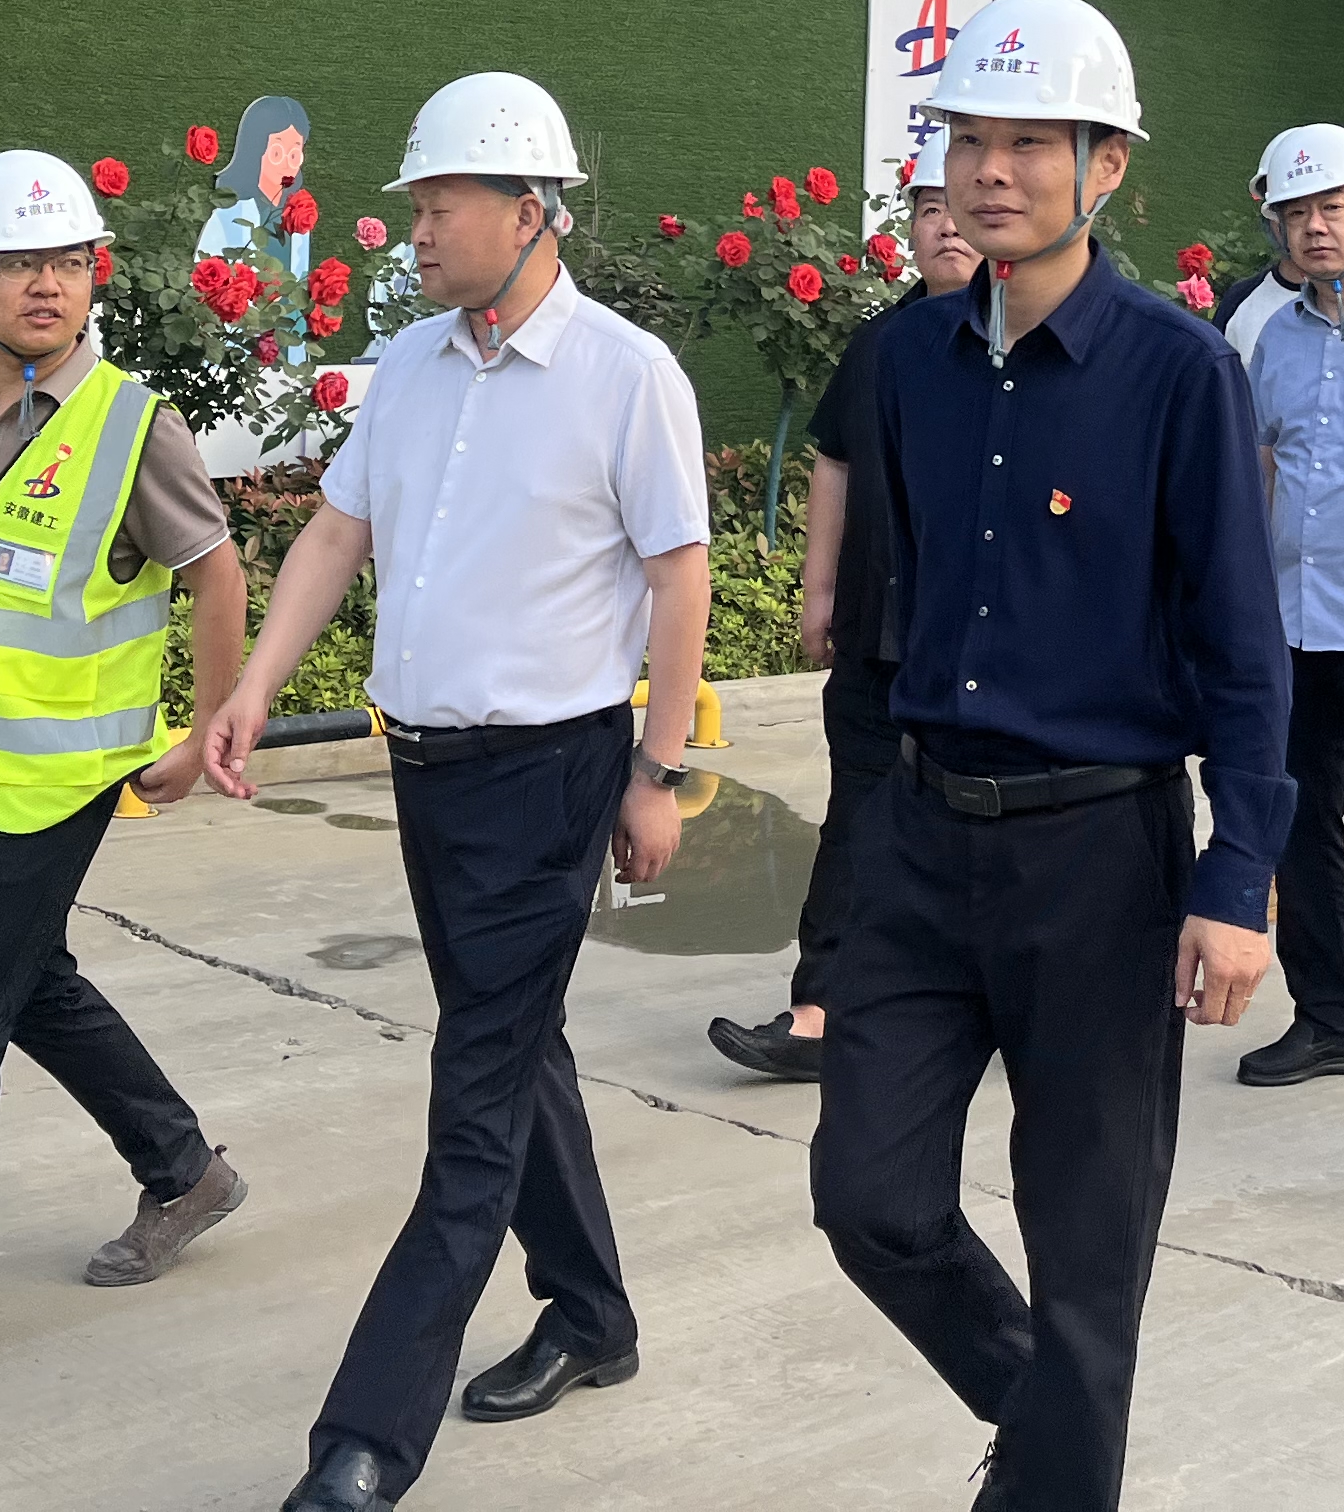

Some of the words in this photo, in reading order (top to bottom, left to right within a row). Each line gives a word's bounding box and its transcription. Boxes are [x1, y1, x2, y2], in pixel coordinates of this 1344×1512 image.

[975, 58, 1040, 75] 安徽建工
[3, 501, 59, 530] 安徽建工
